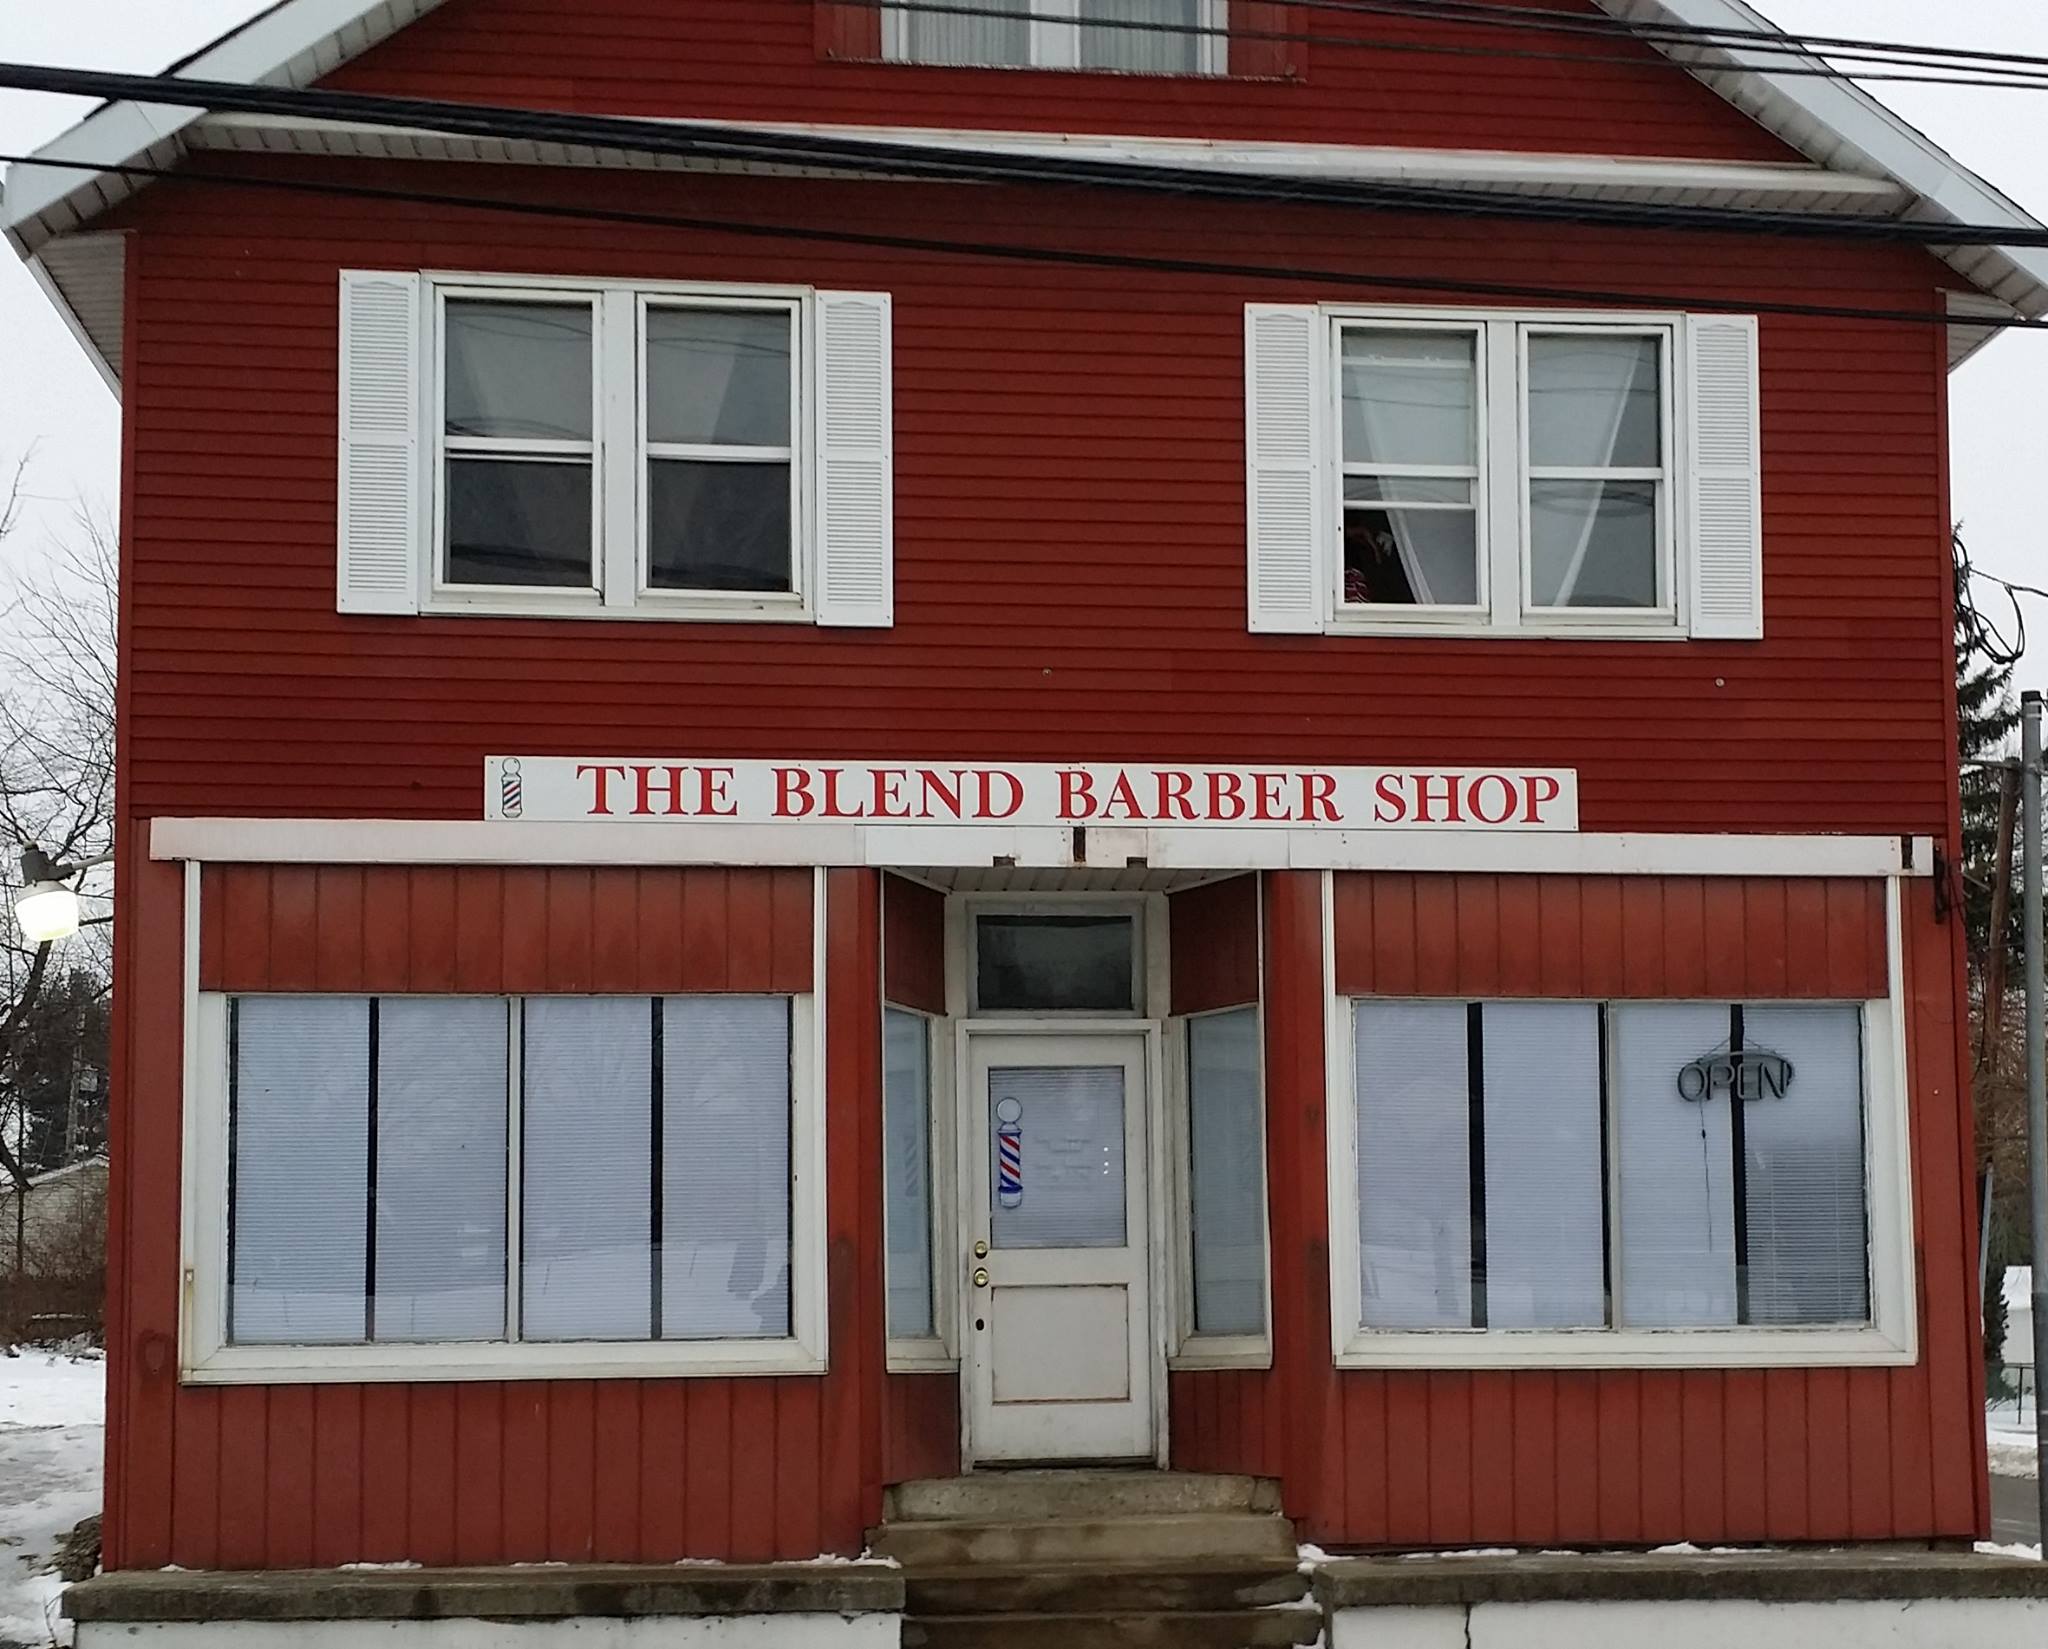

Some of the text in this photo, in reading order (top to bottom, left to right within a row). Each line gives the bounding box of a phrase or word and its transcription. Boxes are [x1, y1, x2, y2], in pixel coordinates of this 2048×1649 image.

[577, 764, 1560, 823] THE BLEND BARBER SHOP
[1677, 1061, 1789, 1102] OPEN
